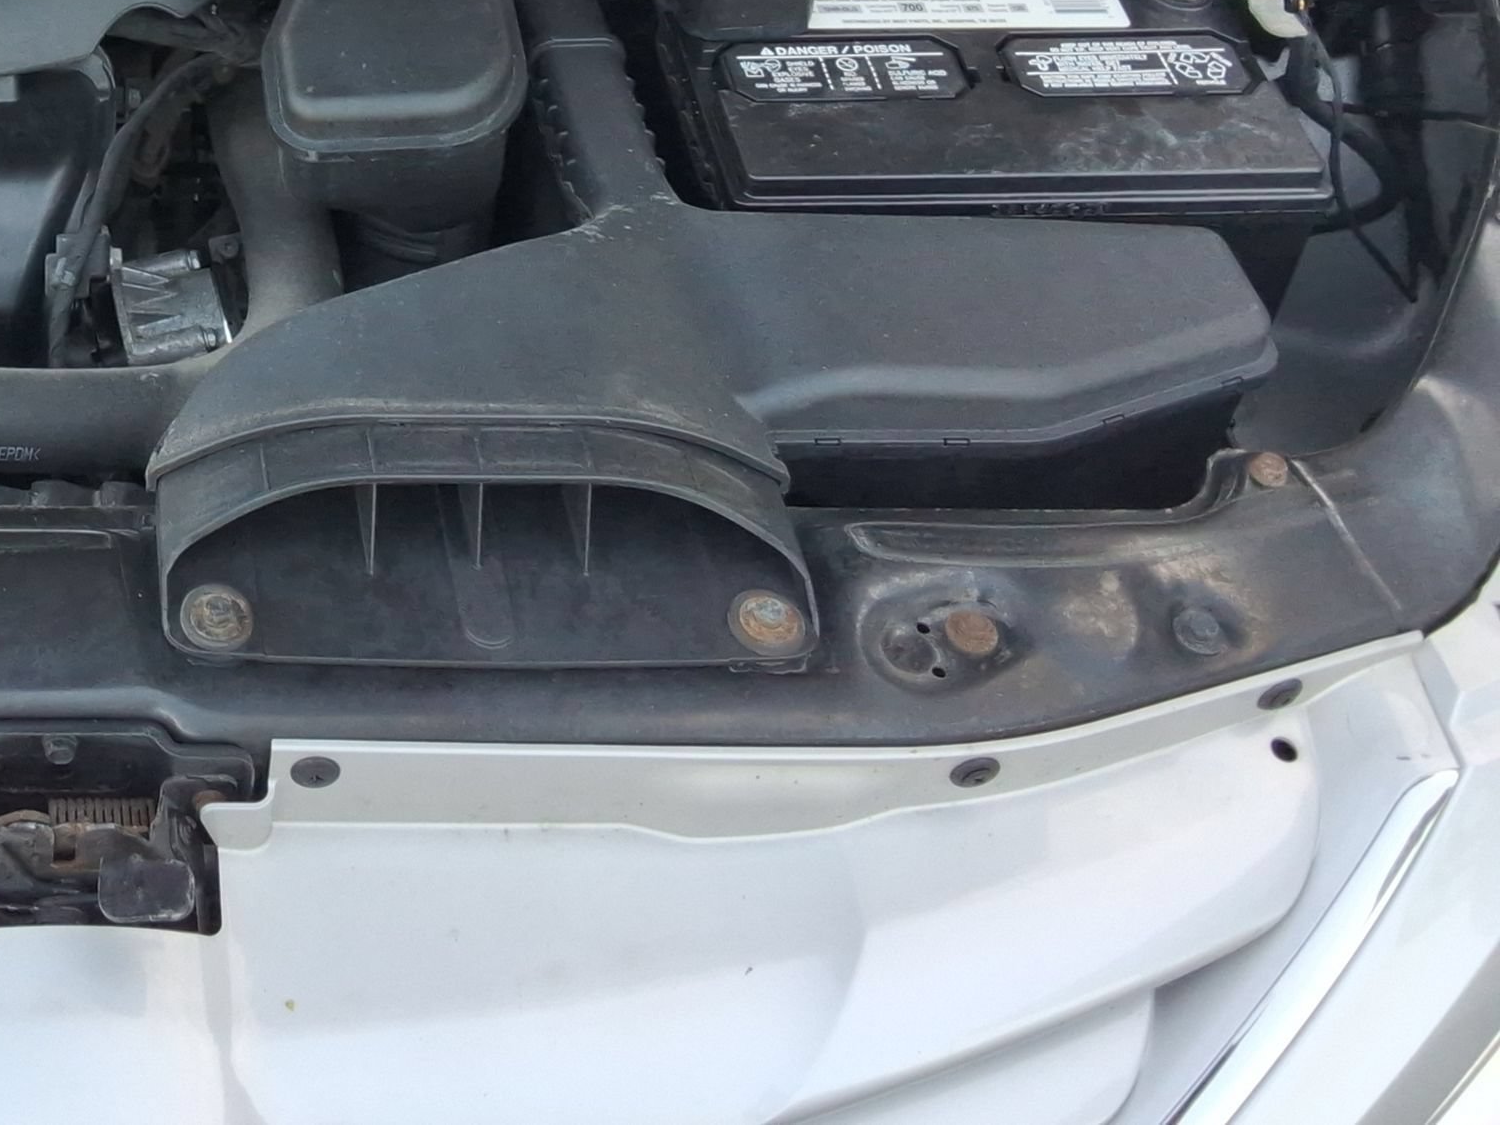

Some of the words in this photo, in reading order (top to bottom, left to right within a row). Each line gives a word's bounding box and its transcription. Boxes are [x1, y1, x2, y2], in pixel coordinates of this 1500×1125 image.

[902, 3, 924, 12] 700
[774, 45, 839, 56] DANGER
[841, 45, 850, 55] /
[853, 44, 912, 54] POISON
